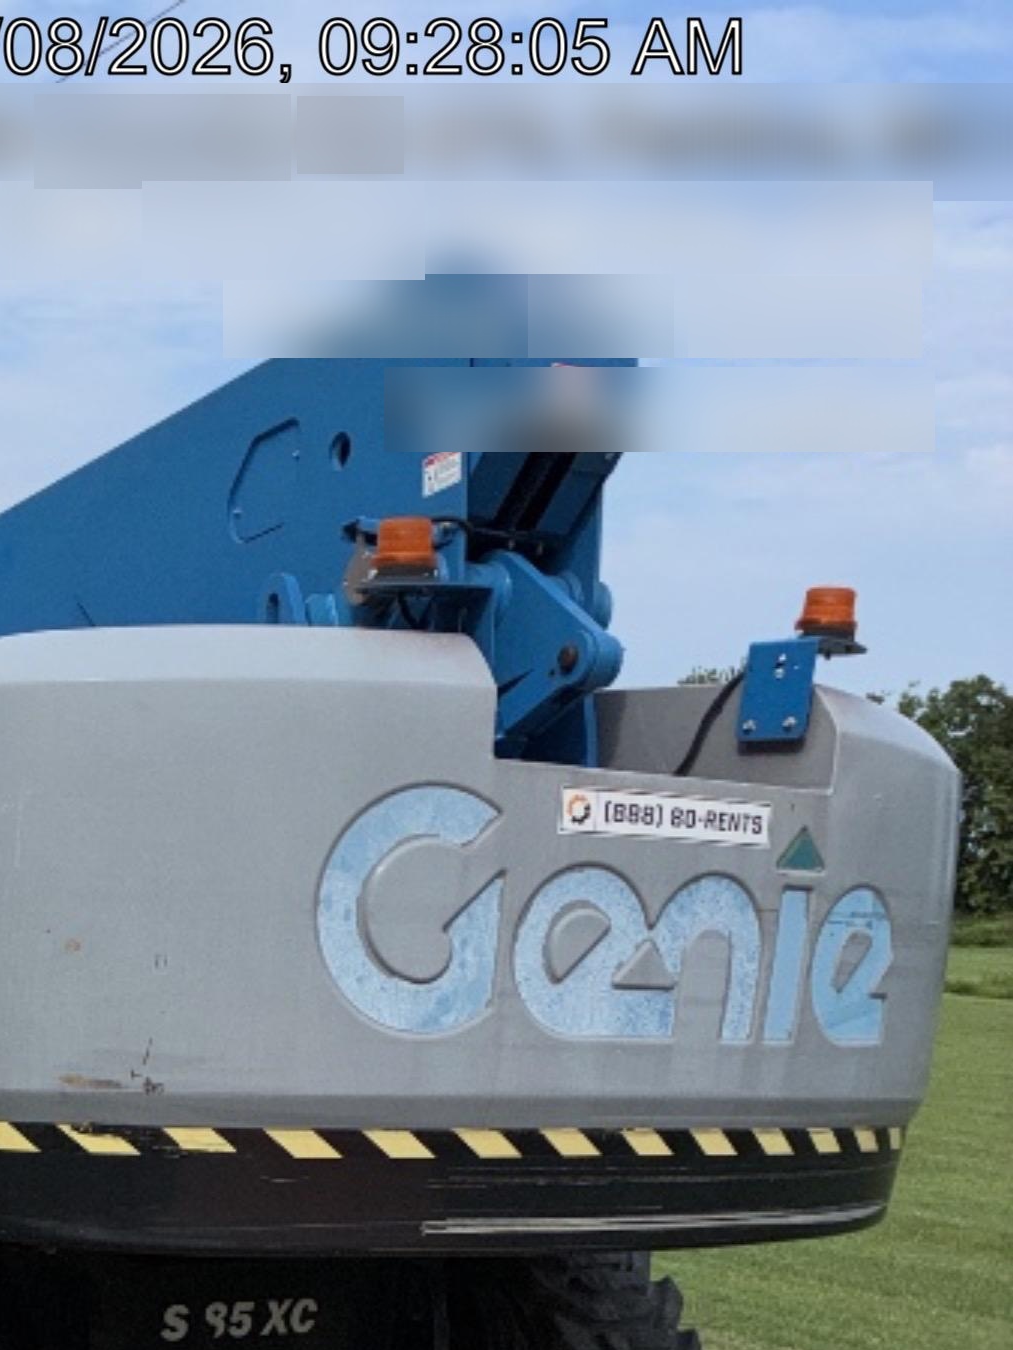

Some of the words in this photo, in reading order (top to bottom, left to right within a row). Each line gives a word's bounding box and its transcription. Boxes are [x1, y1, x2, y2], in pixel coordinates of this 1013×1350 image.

[670, 807, 764, 835] 80-RENTS
[314, 780, 894, 1048] Genie
[260, 1297, 319, 1336] XC
